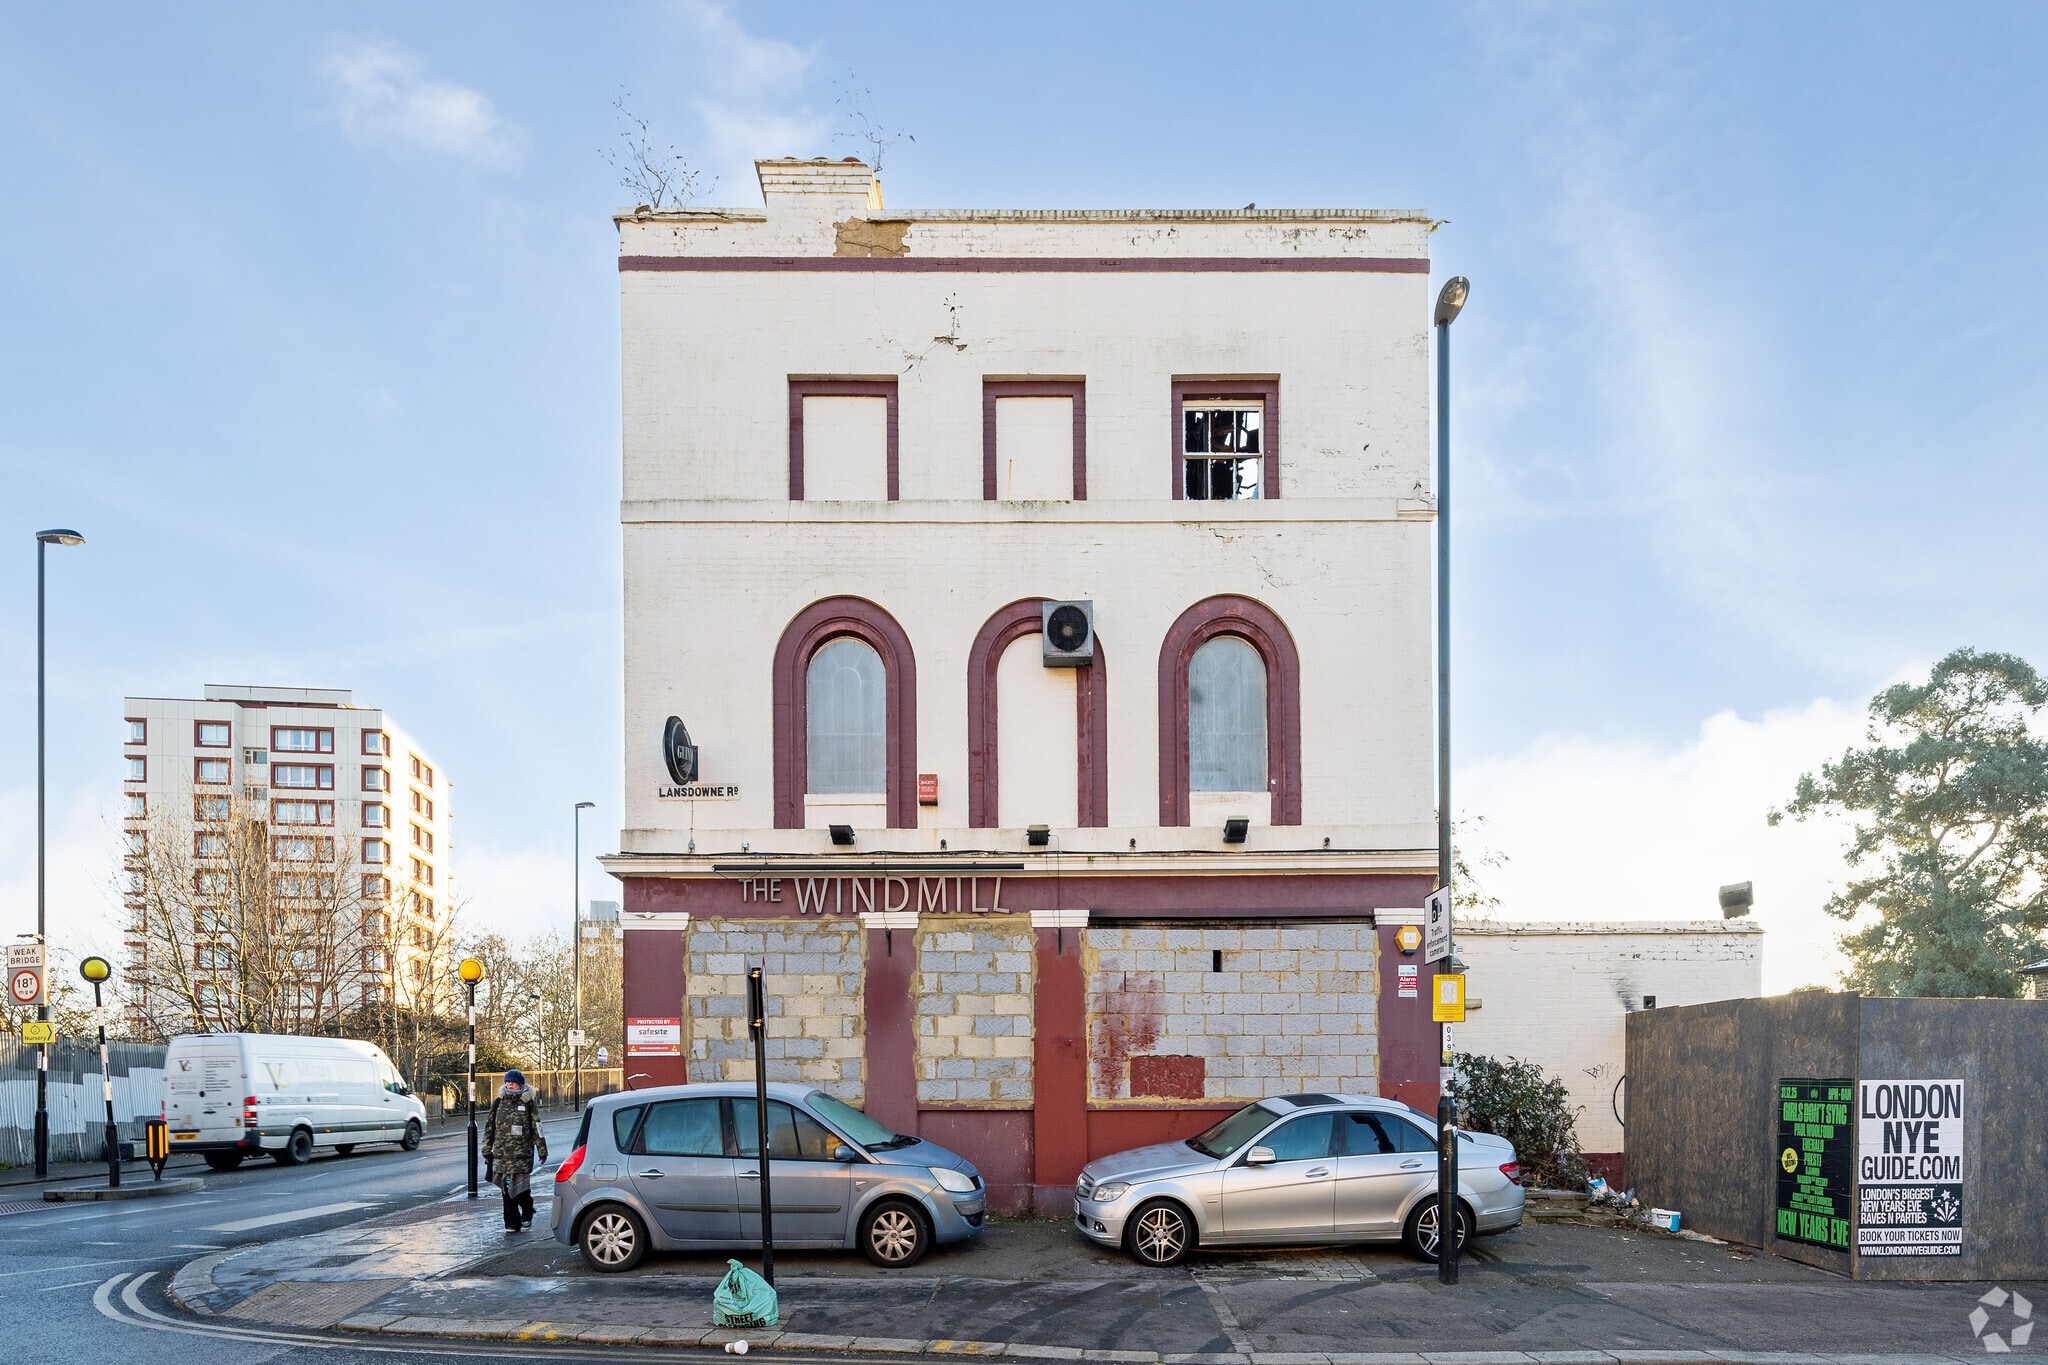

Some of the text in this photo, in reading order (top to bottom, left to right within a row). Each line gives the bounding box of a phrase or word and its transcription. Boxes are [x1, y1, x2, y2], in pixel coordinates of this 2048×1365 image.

[659, 787, 724, 797] LANSDOWNE
[738, 876, 1010, 914] THE WINDMILL
[1431, 926, 1443, 937] Traffic
[1426, 934, 1448, 950] enforcement
[13, 948, 37, 956] WEAK
[1429, 945, 1445, 957] cameras
[10, 956, 40, 965] BRIDGE
[1861, 1084, 1961, 1119] LONDON
[1783, 1101, 1847, 1125] GIRLS DON'T SYNC
[1883, 1121, 1940, 1154] NYE
[1861, 1155, 1960, 1180] GUIDE.COM
[1860, 1188, 1935, 1200] LONDON'S BIGGEST
[1860, 1200, 1922, 1212] NEW YEARS EVE
[1860, 1212, 1928, 1225] RAVES N PARTIES
[1777, 1209, 1849, 1247] NEW YEARS EVE
[1860, 1230, 1960, 1242] BOOK YOUR TICKETS NOW
[1860, 1245, 1960, 1256] WWW.LONDONNYEGUIDE.COM
[724, 1312, 754, 1325] STREET
